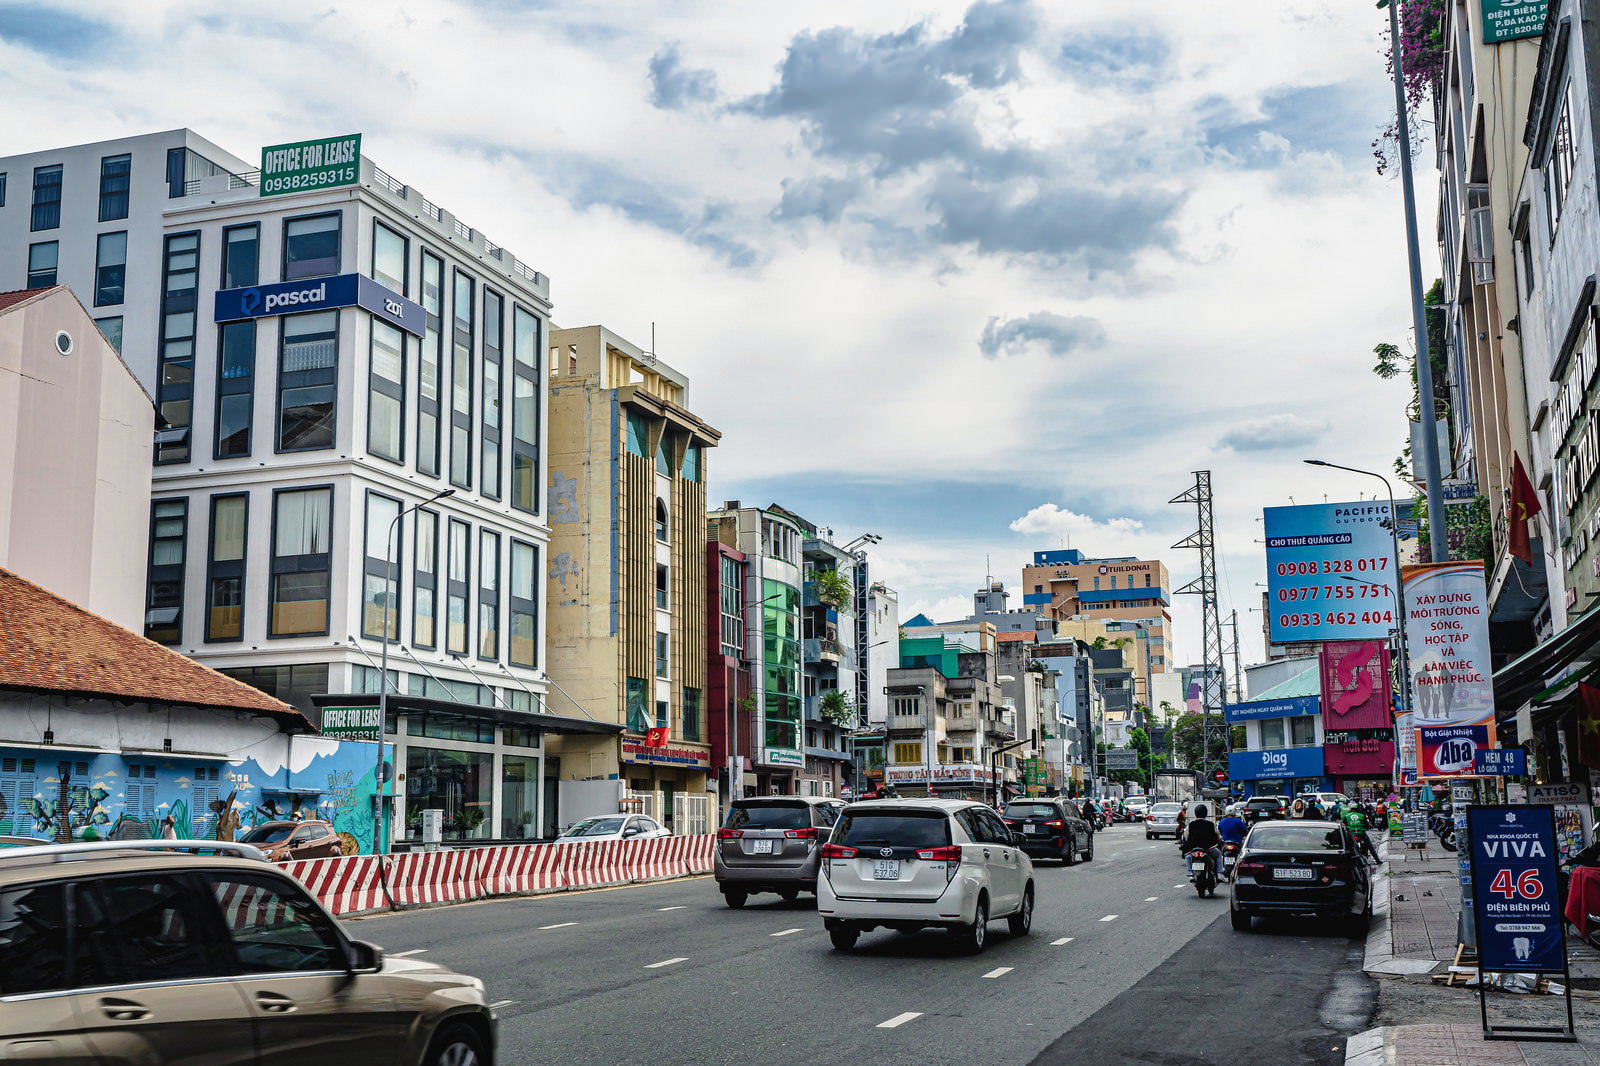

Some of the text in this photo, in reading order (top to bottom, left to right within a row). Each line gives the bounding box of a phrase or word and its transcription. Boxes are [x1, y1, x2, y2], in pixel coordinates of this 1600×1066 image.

[1487, 10, 1510, 20] ĐIỆN
[1514, 6, 1536, 16] BIÊN
[265, 140, 356, 174] OFFICE FOR LEASE
[264, 168, 354, 192] 0938259315
[266, 282, 326, 312] pascal
[1335, 506, 1389, 516] PACIFIC
[1270, 534, 1350, 546] CHO THUÊ QUẢNG CÁO
[1277, 557, 1388, 576] 0908 328 017
[1278, 584, 1389, 602] 0977 755 751
[1416, 592, 1472, 605] XÂY DỰNG
[1280, 610, 1392, 628] 0933 462 404
[1410, 605, 1480, 619] MÔI TRƯỜNG
[1424, 632, 1469, 646] HỌC TẬP
[1442, 646, 1455, 656] VÀ
[1425, 659, 1473, 672] LÀM VIỆC
[1418, 672, 1484, 688] HẠNH PHÚC.
[324, 710, 346, 728] OFFICE
[347, 710, 360, 727] FOR
[1424, 728, 1473, 738] Bột Giặt Nhiệt
[1440, 741, 1472, 765] Aba
[1505, 752, 1514, 764] 48
[1534, 784, 1580, 797] ATISÔ
[1482, 840, 1546, 858] VIVA
[1490, 868, 1544, 900] 46
[1486, 902, 1550, 913] ĐIỆN BIÊN PHỦ
